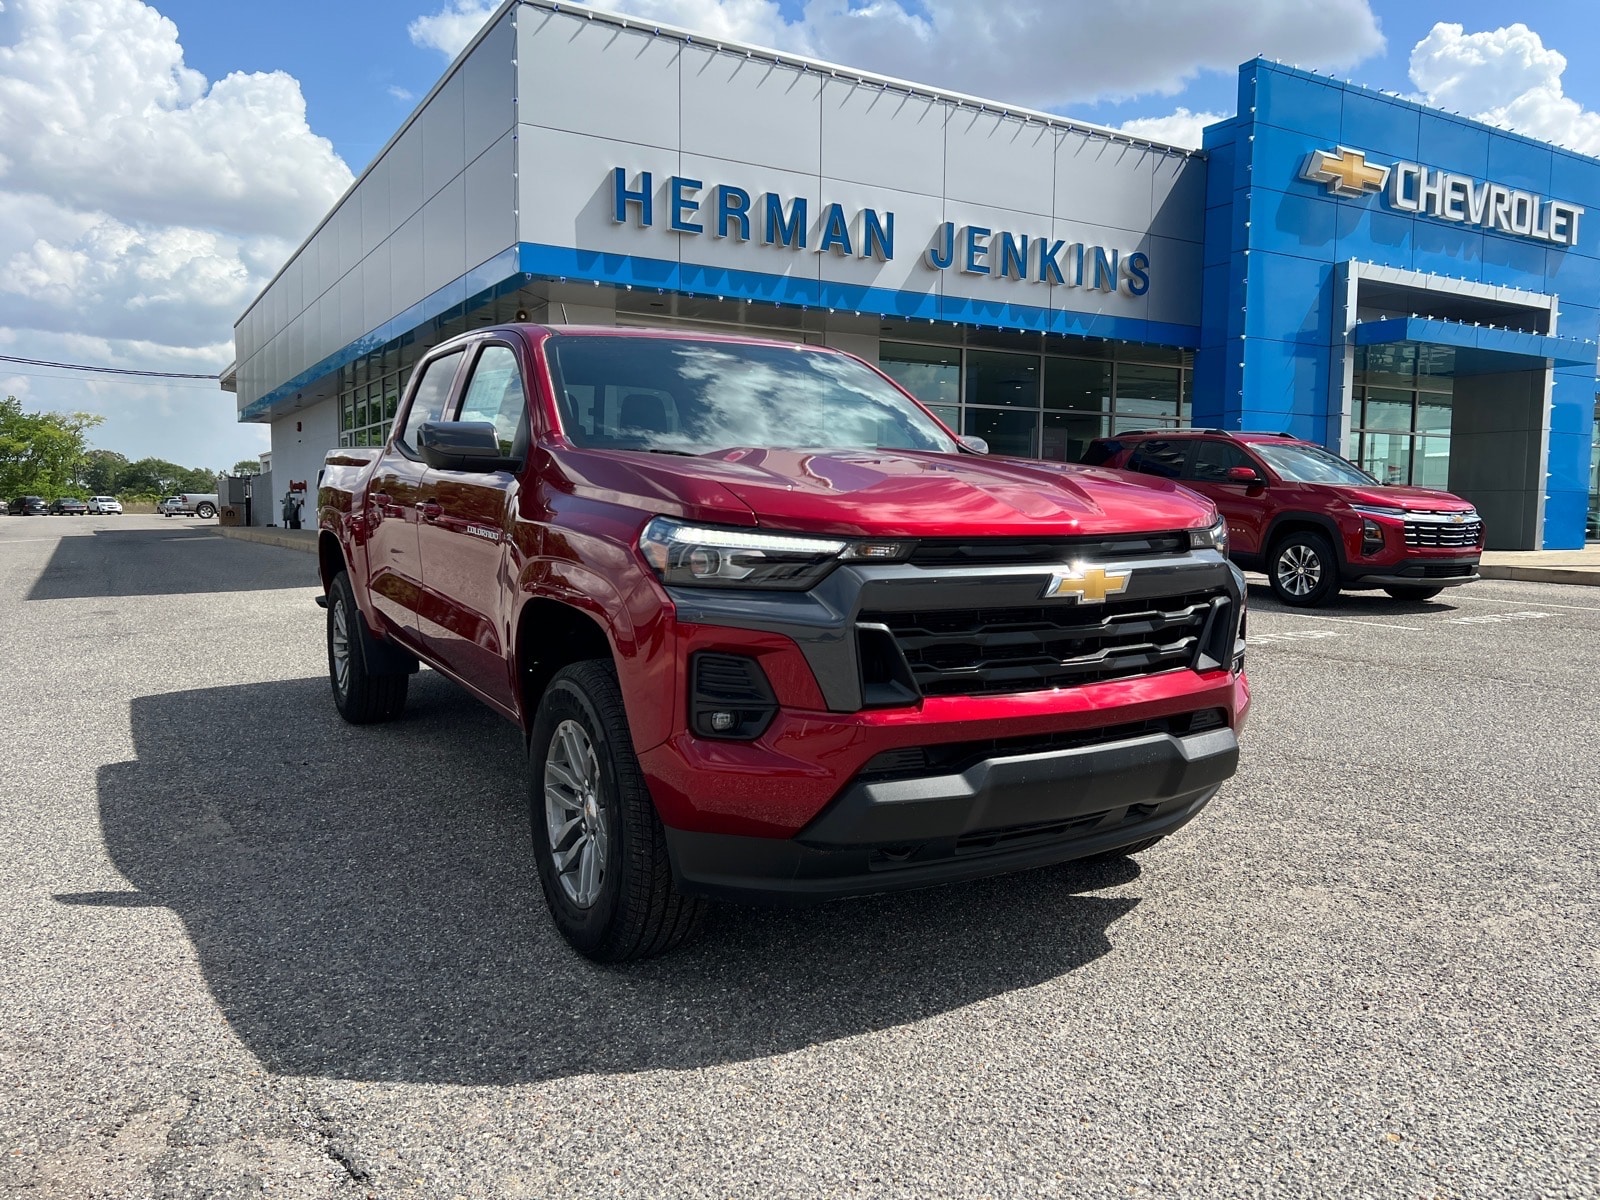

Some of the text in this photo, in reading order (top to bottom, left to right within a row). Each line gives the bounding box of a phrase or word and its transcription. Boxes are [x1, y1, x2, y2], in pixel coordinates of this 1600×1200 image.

[612, 166, 1150, 297] HERMAN JENKINS
[1391, 161, 1585, 246] CHEVROLET
